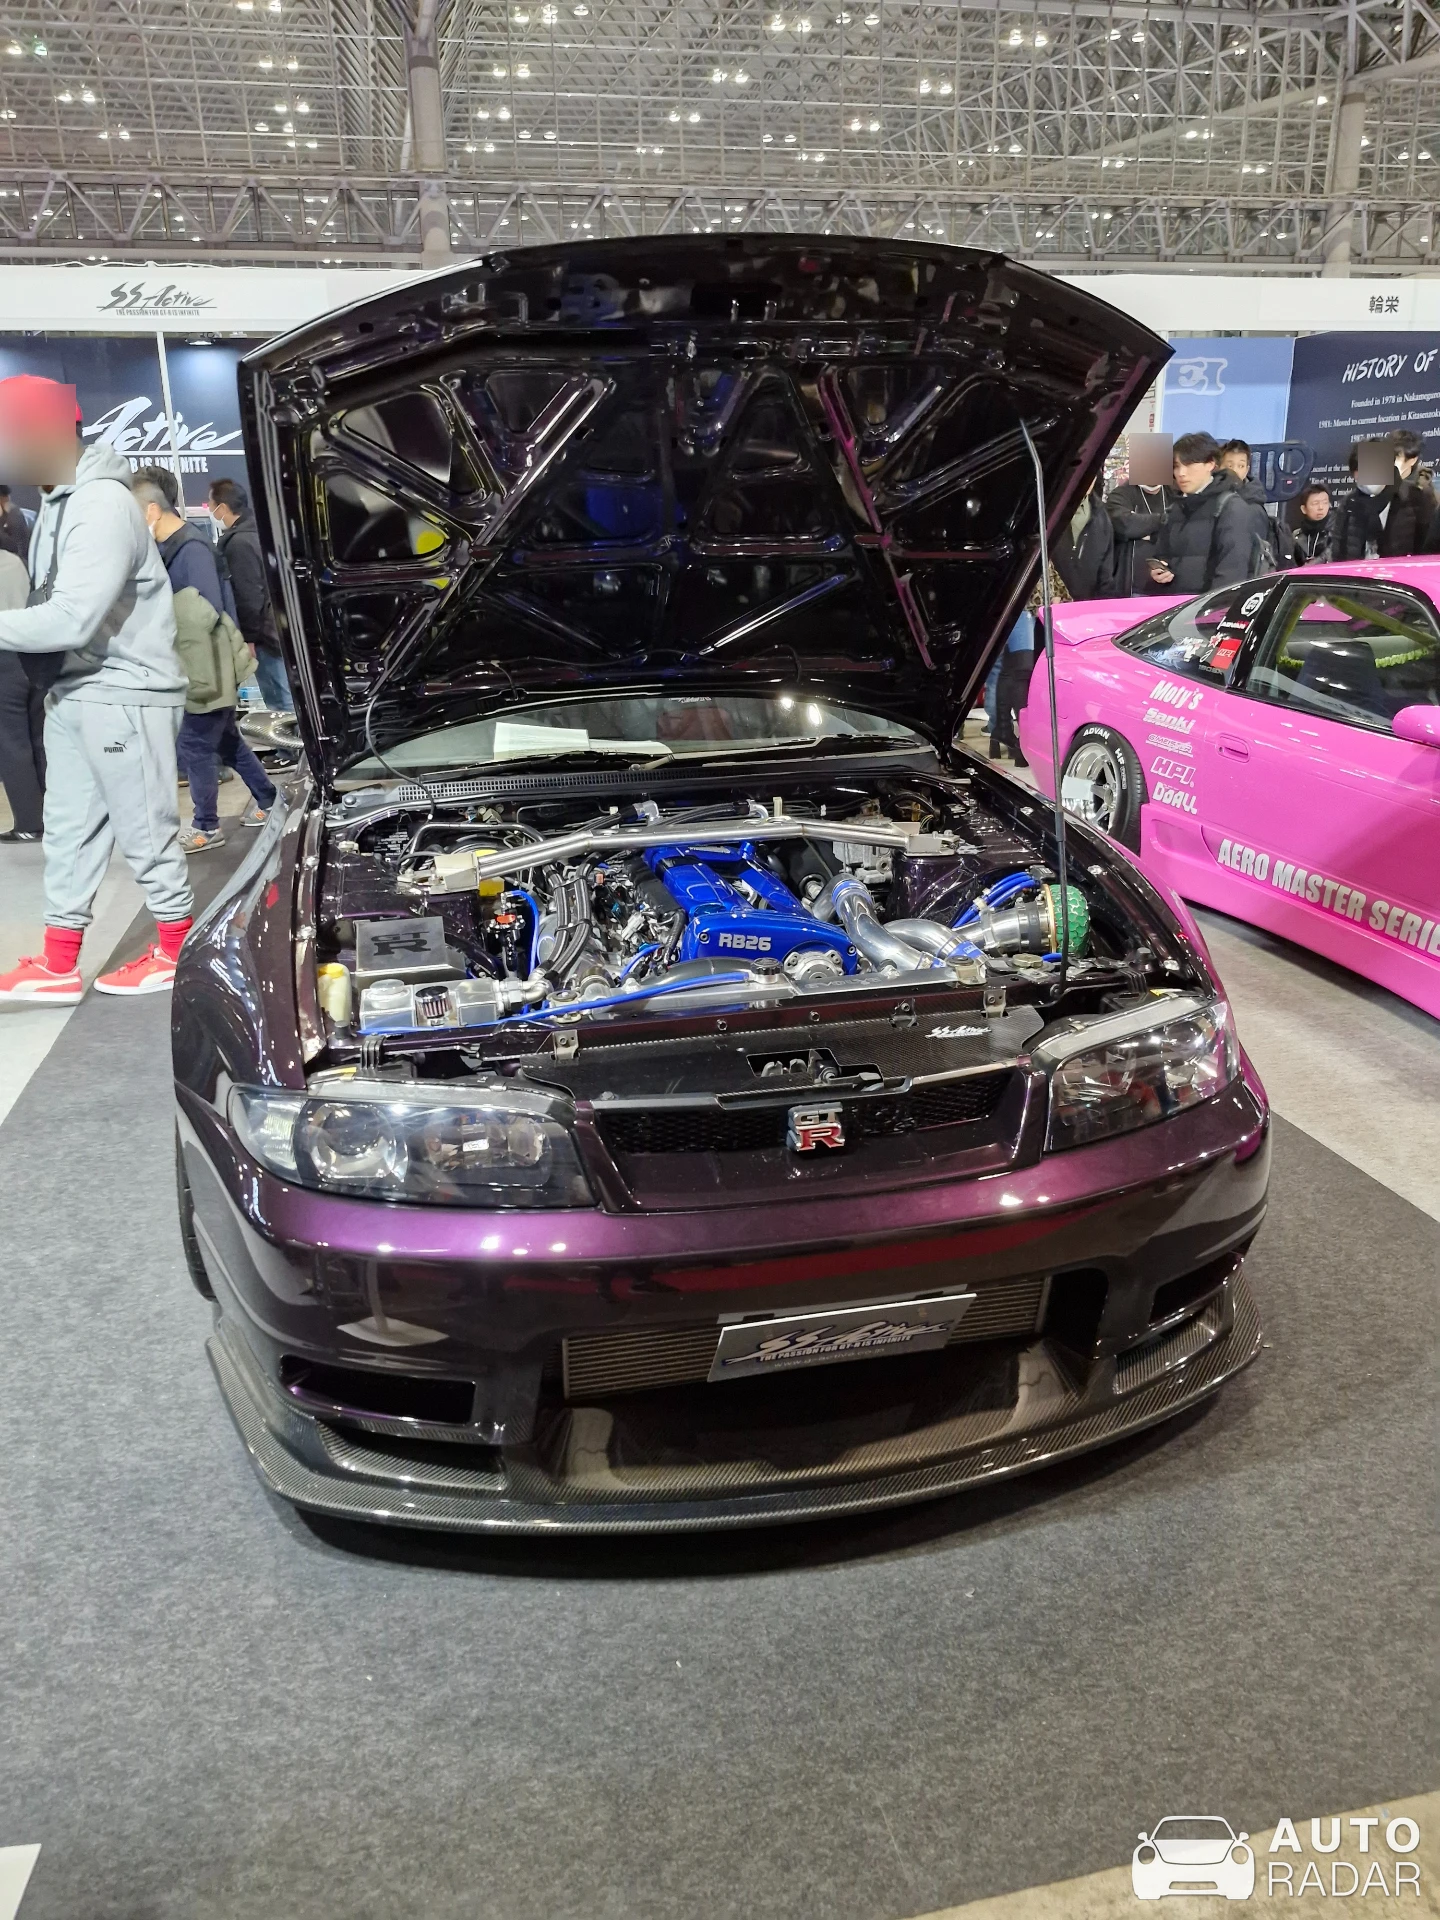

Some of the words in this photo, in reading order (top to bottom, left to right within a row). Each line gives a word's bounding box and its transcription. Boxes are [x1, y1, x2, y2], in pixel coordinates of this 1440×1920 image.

[1368, 296, 1400, 315] 輪栄
[1342, 354, 1408, 384] HISTORY
[1414, 349, 1438, 373] OF
[155, 457, 208, 473] INFNITE
[1149, 680, 1204, 710] Moty's
[1083, 728, 1110, 740] ADVAN
[1217, 838, 1270, 881] AERO
[1271, 860, 1367, 922] MASTER
[718, 933, 772, 951] RB26
[792, 1103, 843, 1127] GT
[795, 1122, 846, 1152] R
[760, 1353, 776, 1362] THE
[778, 1347, 819, 1359] PASSION
[820, 1344, 838, 1353] FOR
[838, 1341, 861, 1350] GT-R
[872, 1334, 912, 1345] INFINITE
